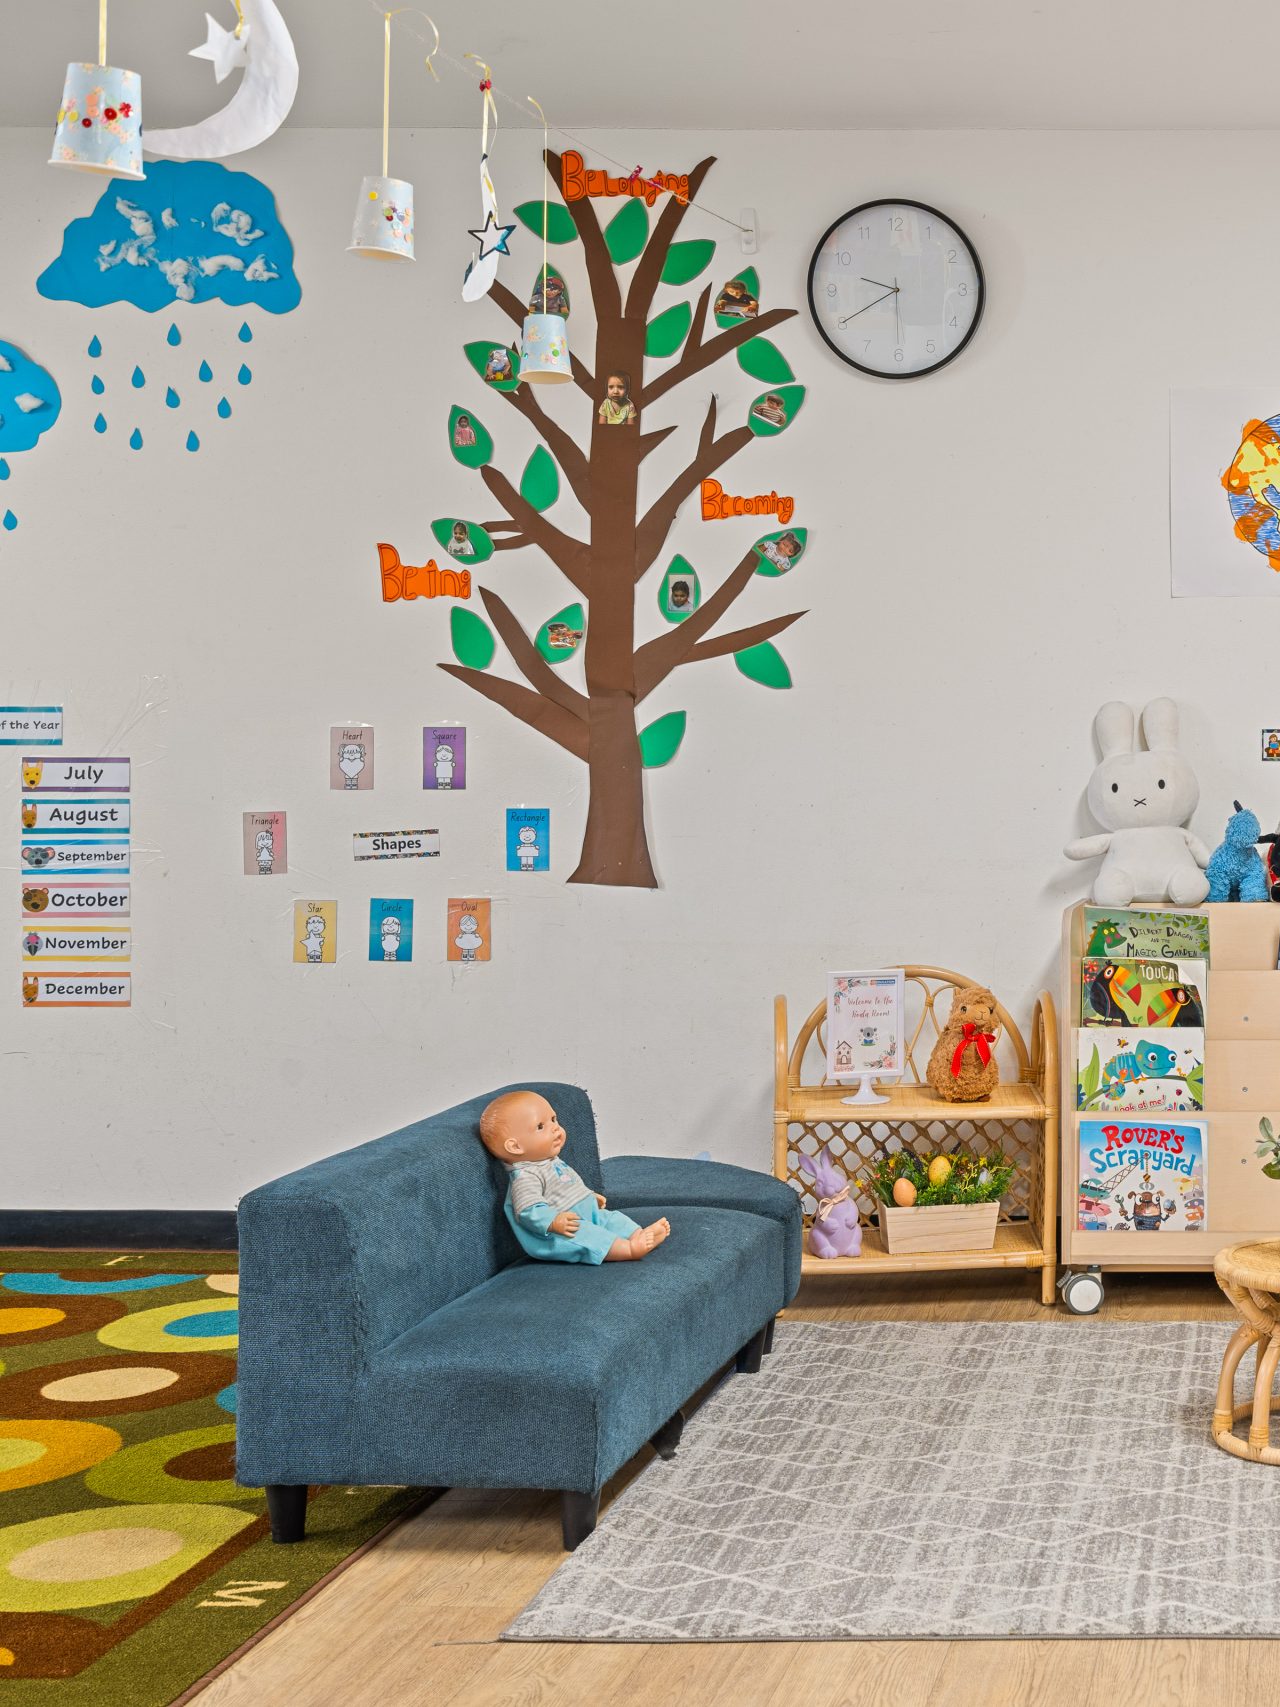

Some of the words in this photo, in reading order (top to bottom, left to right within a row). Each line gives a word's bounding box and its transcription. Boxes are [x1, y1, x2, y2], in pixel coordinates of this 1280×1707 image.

[888, 217, 904, 231] 12
[858, 226, 870, 240] 11
[926, 226, 931, 240] 1
[836, 251, 852, 266] 10
[947, 249, 957, 264] 2
[827, 283, 838, 297] 9
[958, 283, 968, 297] 3
[837, 316, 848, 330] 8
[949, 315, 958, 328] 4
[863, 339, 872, 352] 7
[926, 340, 936, 353] 5
[894, 348, 904, 362] 6
[701, 478, 794, 524] Becoming
[378, 543, 471, 602] Being
[0, 720, 7, 730] f
[10, 720, 29, 730] the
[33, 720, 60, 730] Year
[342, 730, 363, 740] Heart
[432, 730, 457, 743] Square
[64, 765, 104, 784] July
[49, 807, 119, 825] August
[250, 813, 280, 829] Triangle
[511, 811, 545, 826] Rectangle
[372, 838, 422, 852] Shapes
[57, 851, 127, 864] September
[51, 891, 128, 907] October
[307, 902, 324, 913] Star
[381, 901, 403, 912] Circle
[461, 901, 478, 912] Oval
[45, 937, 127, 949] November
[1126, 943, 1157, 957] MAGIC
[1161, 944, 1198, 958] GARDEN
[45, 982, 125, 995] December
[1137, 1100, 1147, 1109] at
[1101, 1125, 1185, 1154] ROVER'S
[1089, 1148, 1196, 1176] Scrapyard
